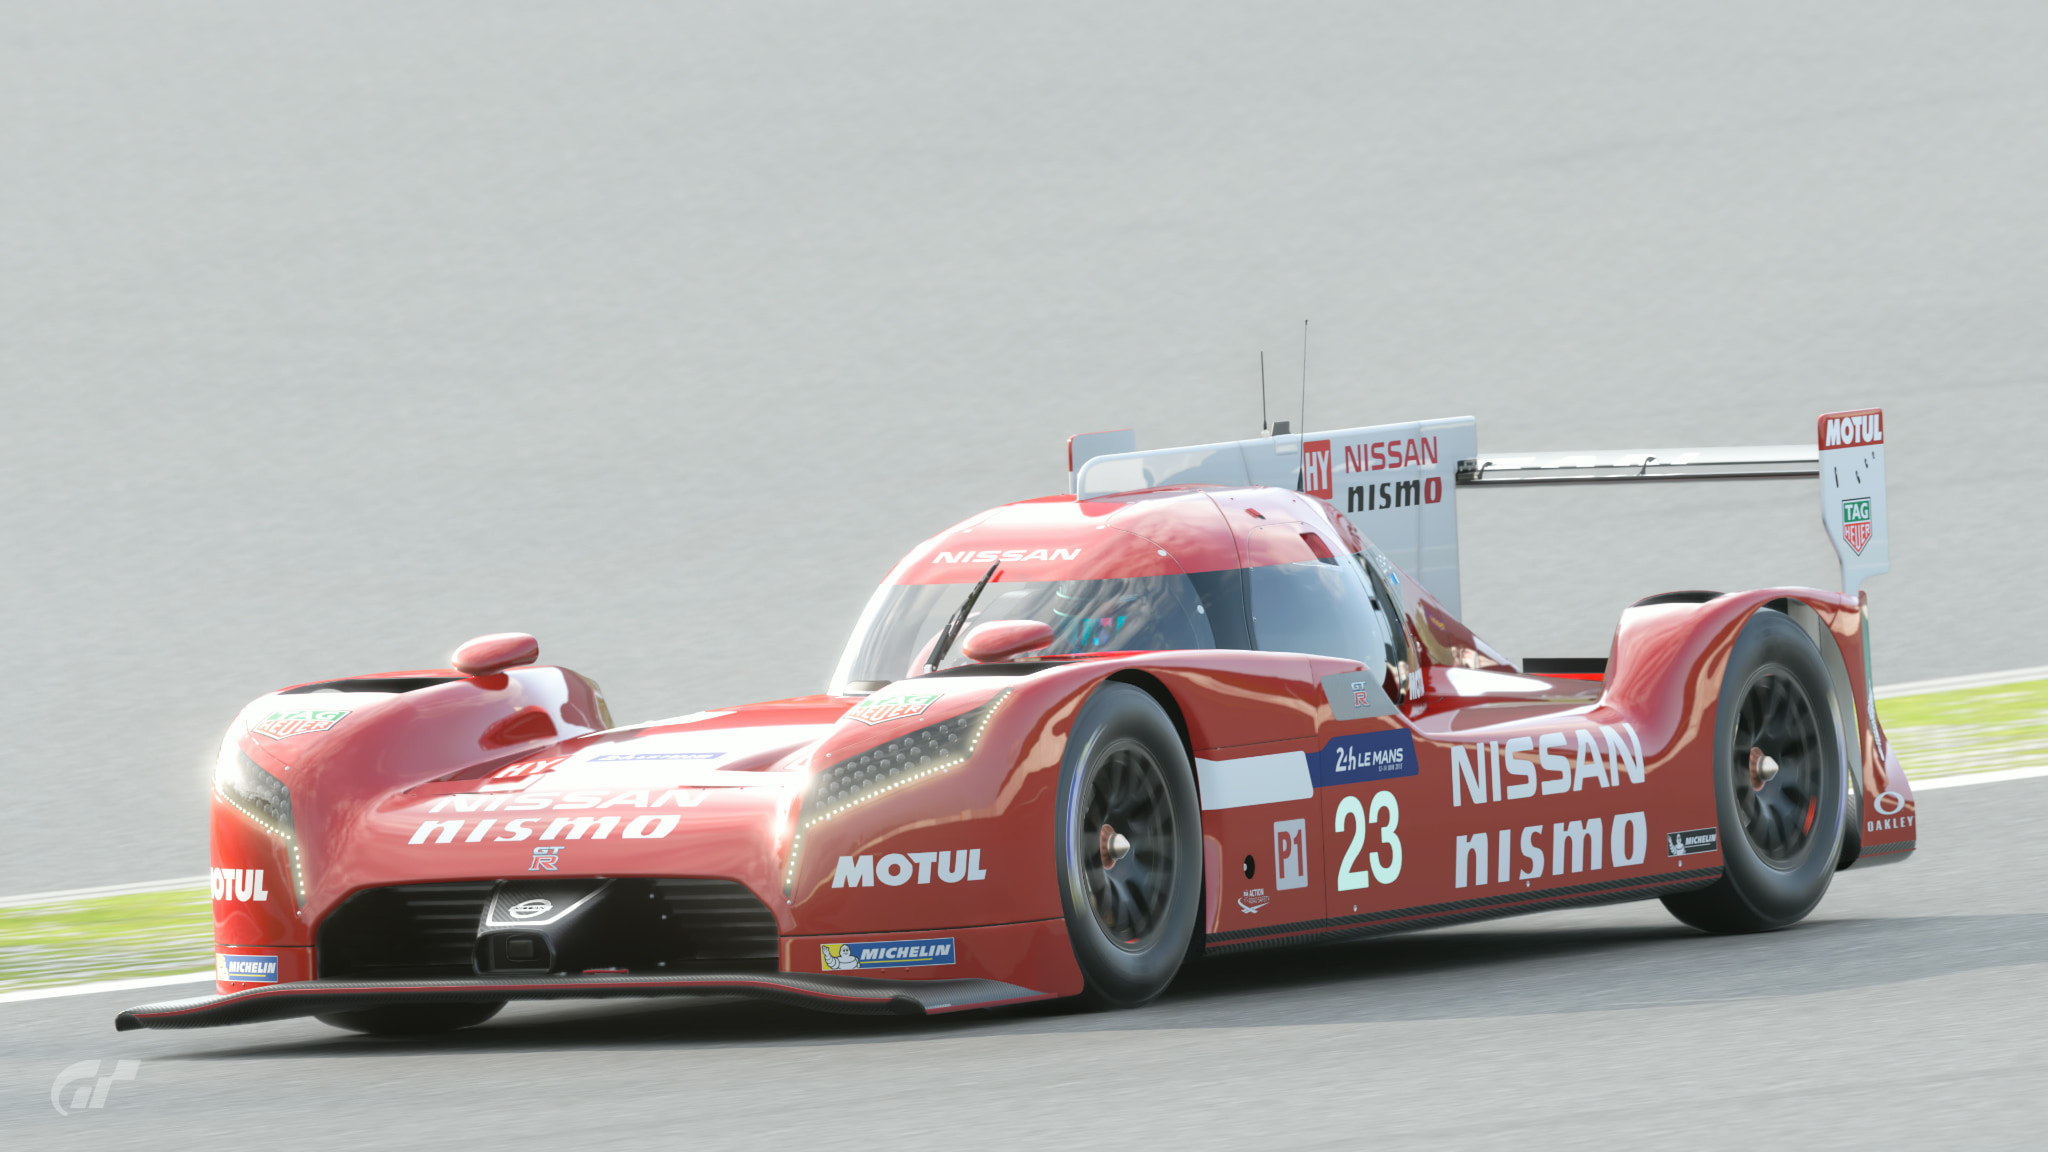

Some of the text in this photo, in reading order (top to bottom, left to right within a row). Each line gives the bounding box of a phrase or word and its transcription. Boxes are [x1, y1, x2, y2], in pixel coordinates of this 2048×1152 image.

[1825, 414, 1882, 447] MOTUL
[1345, 436, 1438, 474] NISSAN
[1305, 450, 1330, 492] HY
[1347, 476, 1442, 513] nismo
[1845, 502, 1869, 521] TAG
[1844, 524, 1871, 549] HEUER
[932, 548, 1082, 564] NISSAN
[274, 710, 341, 721] TAG
[848, 704, 920, 721] HEUER
[256, 719, 329, 737] HEUER
[499, 757, 566, 779] HY
[1357, 751, 1372, 767] LE
[1372, 747, 1404, 766] MANS
[1450, 722, 1646, 808] NISSAN
[428, 789, 706, 813] NISSAN
[407, 814, 681, 845] nismo
[1867, 815, 1915, 832] OAKLEY
[1335, 790, 1403, 891] 23
[1455, 811, 1648, 889] nismo
[1684, 834, 1717, 845] MICHELIN
[1277, 829, 1304, 879] P1
[831, 848, 987, 889] MOTUL
[210, 867, 269, 902] OTUL
[859, 944, 951, 961] MICHELIN
[229, 961, 277, 974] MICHELIN
